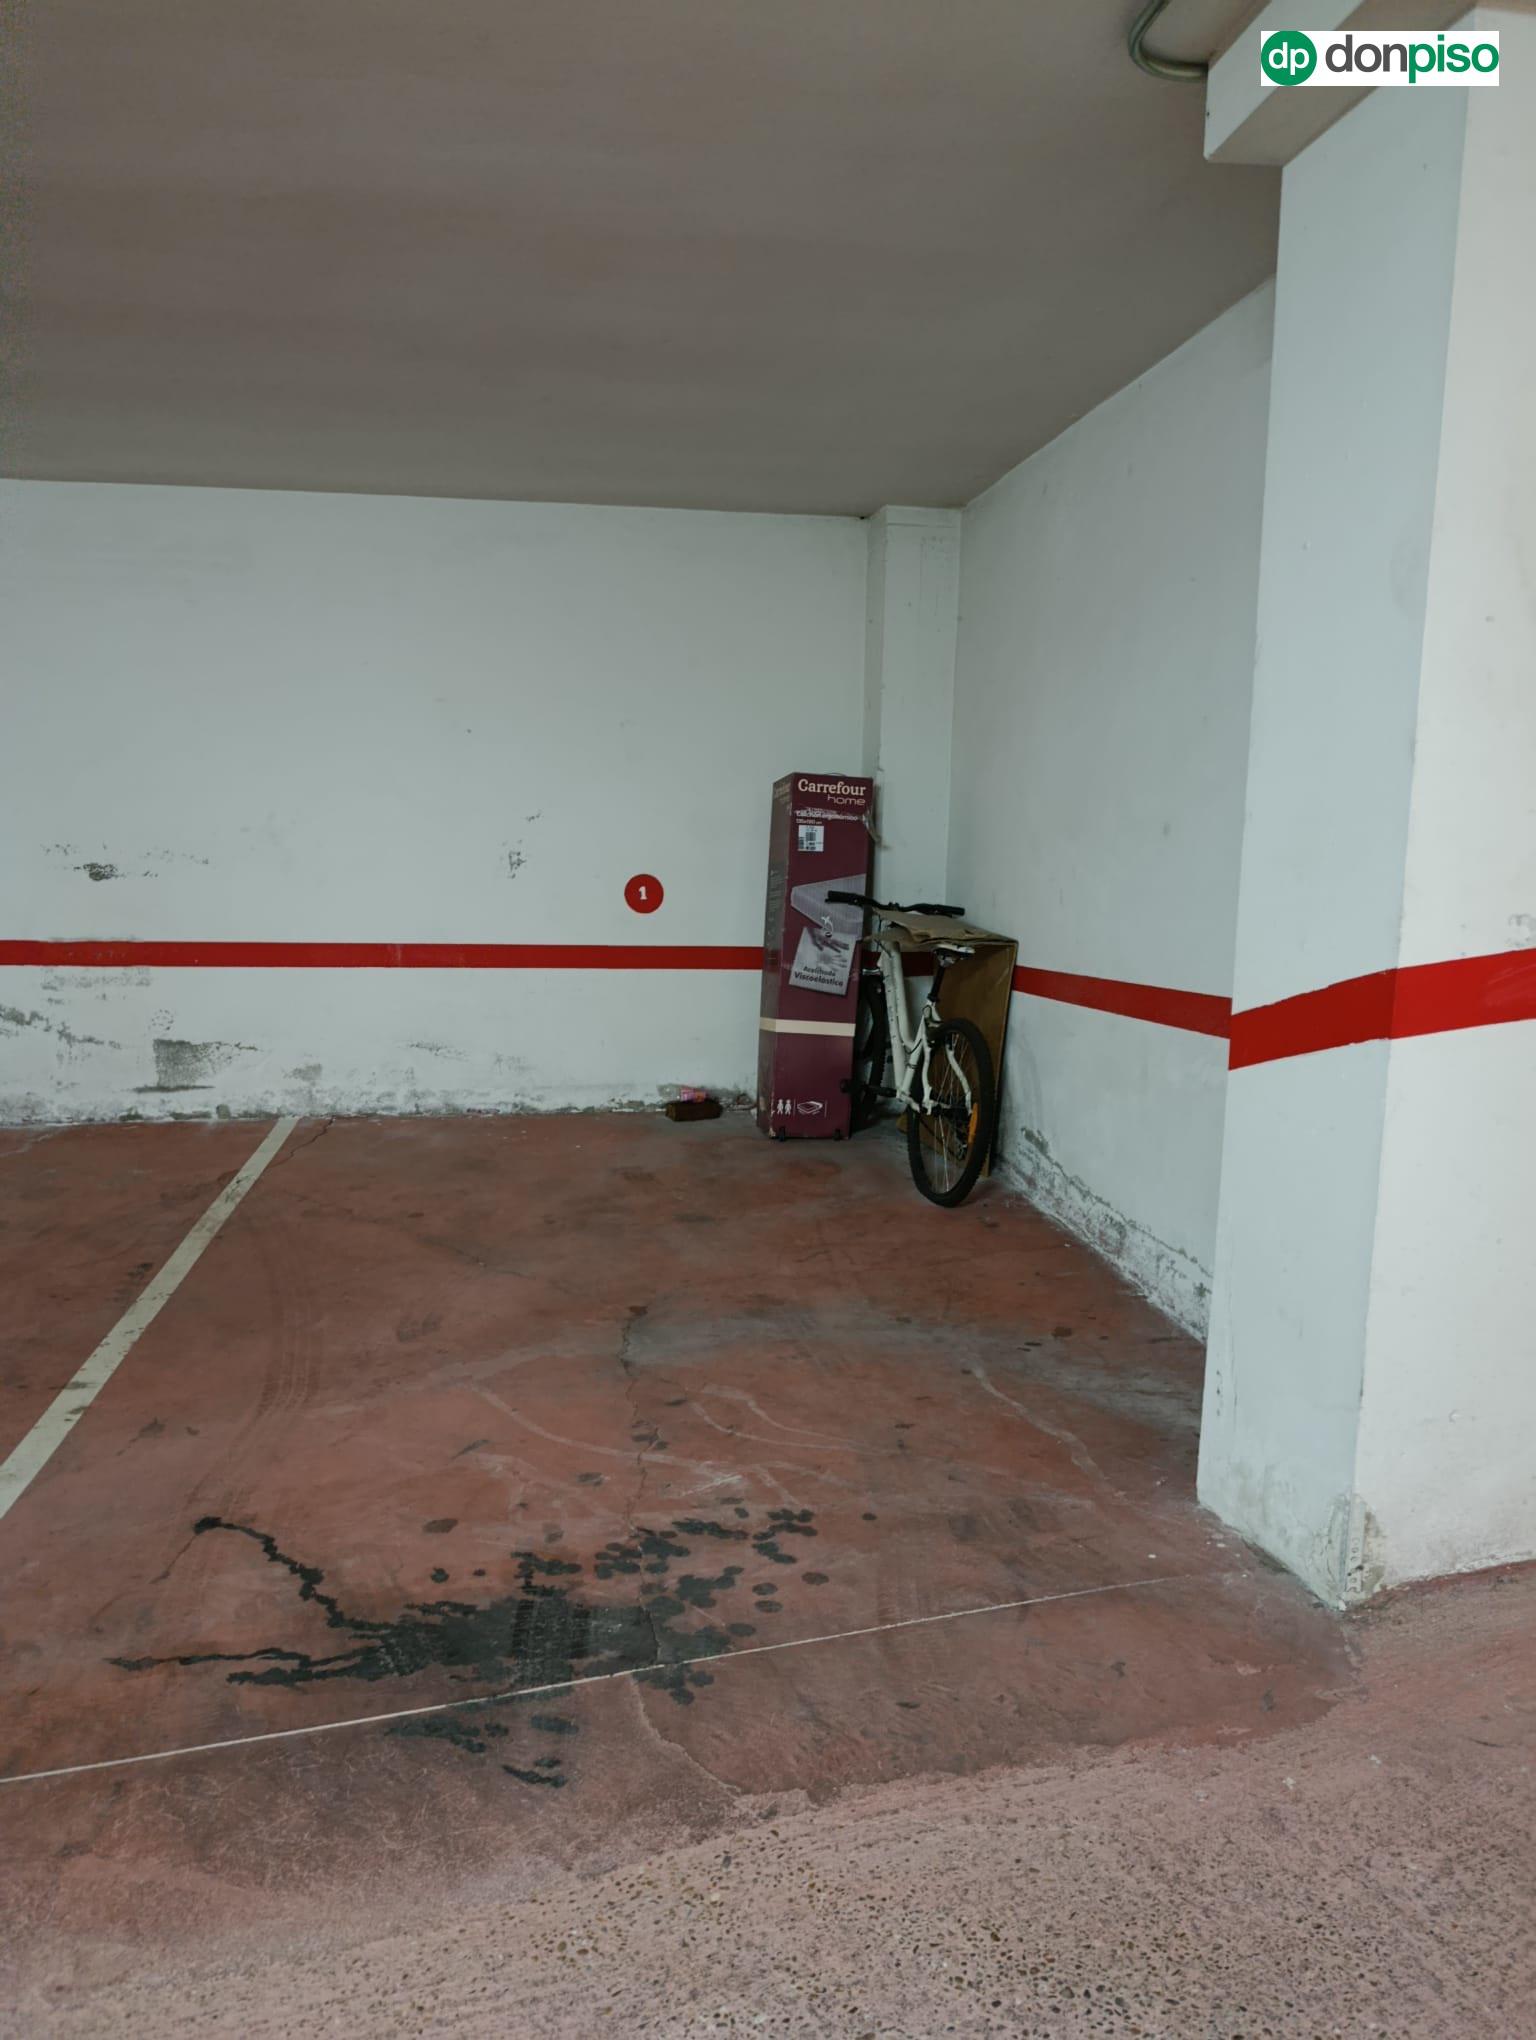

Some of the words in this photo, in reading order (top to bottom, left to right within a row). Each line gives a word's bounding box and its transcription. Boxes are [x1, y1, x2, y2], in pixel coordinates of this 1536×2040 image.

[797, 778, 867, 796] Carrefour
[827, 794, 866, 806] home
[638, 885, 648, 900] 1
